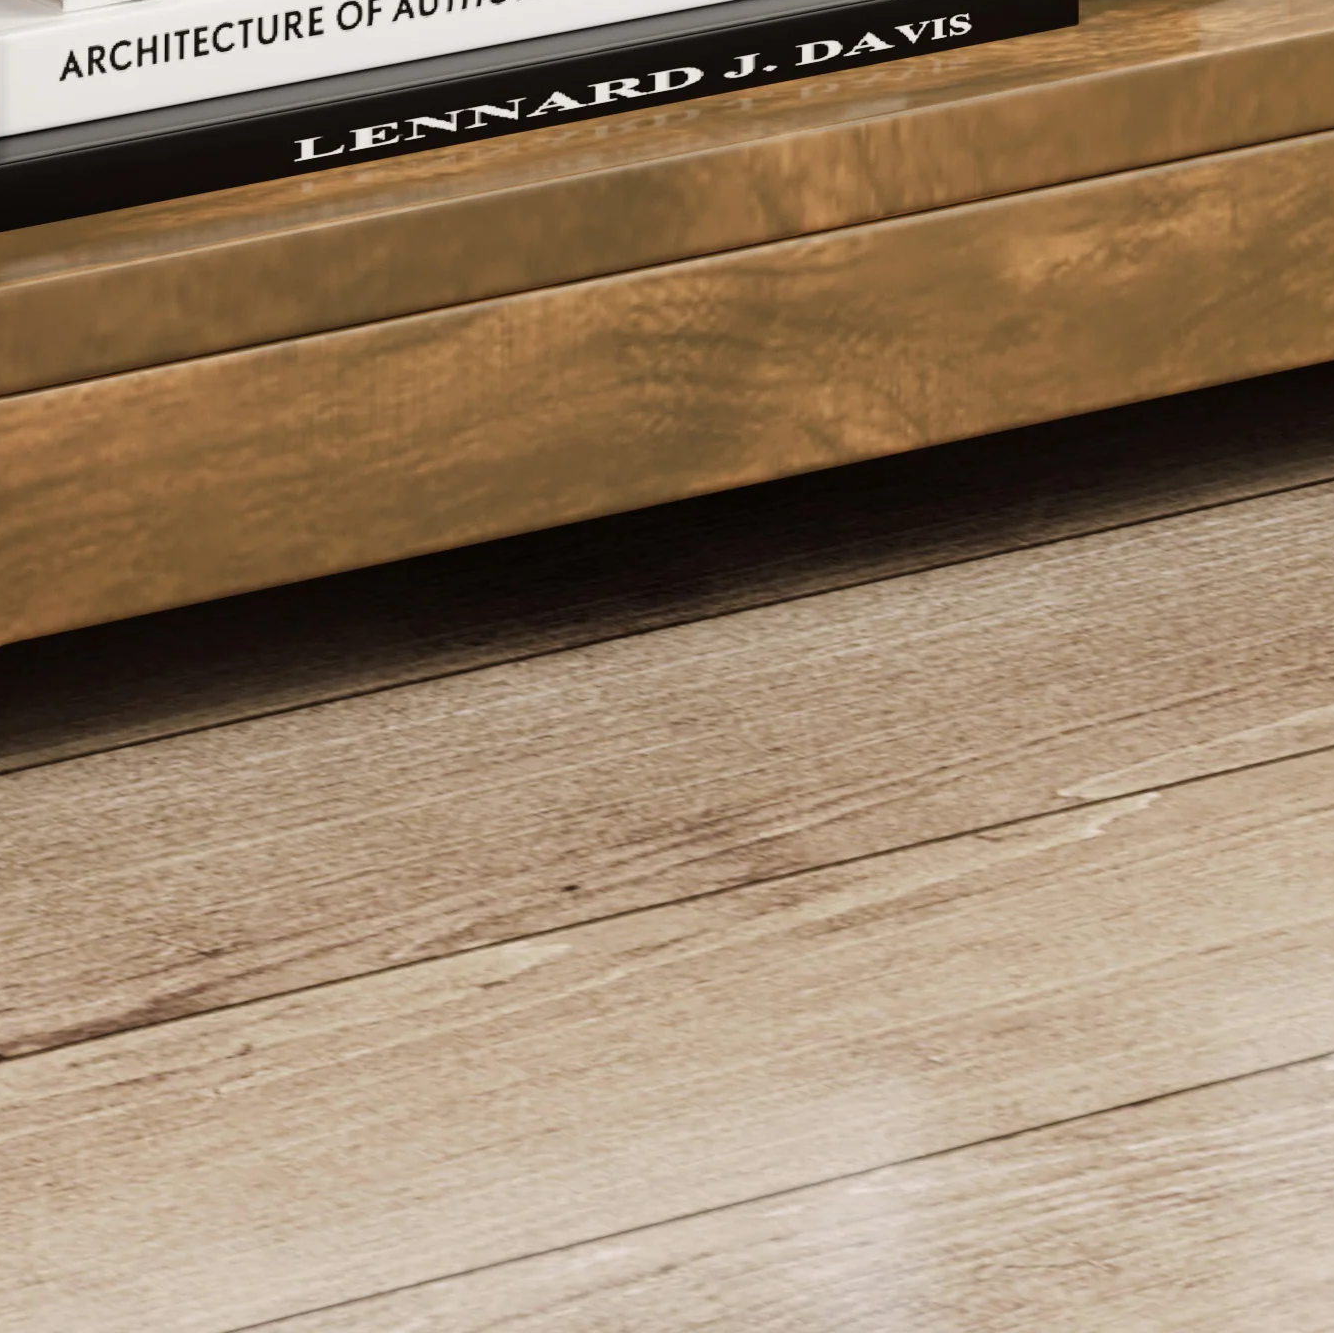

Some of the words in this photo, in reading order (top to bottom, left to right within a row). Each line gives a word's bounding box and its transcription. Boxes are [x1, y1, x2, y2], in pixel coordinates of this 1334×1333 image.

[58, 0, 325, 82] ARCHITECTURE
[292, 64, 704, 162] LENNARD
[722, 52, 777, 82] J.
[794, 11, 973, 69] DAVIS
